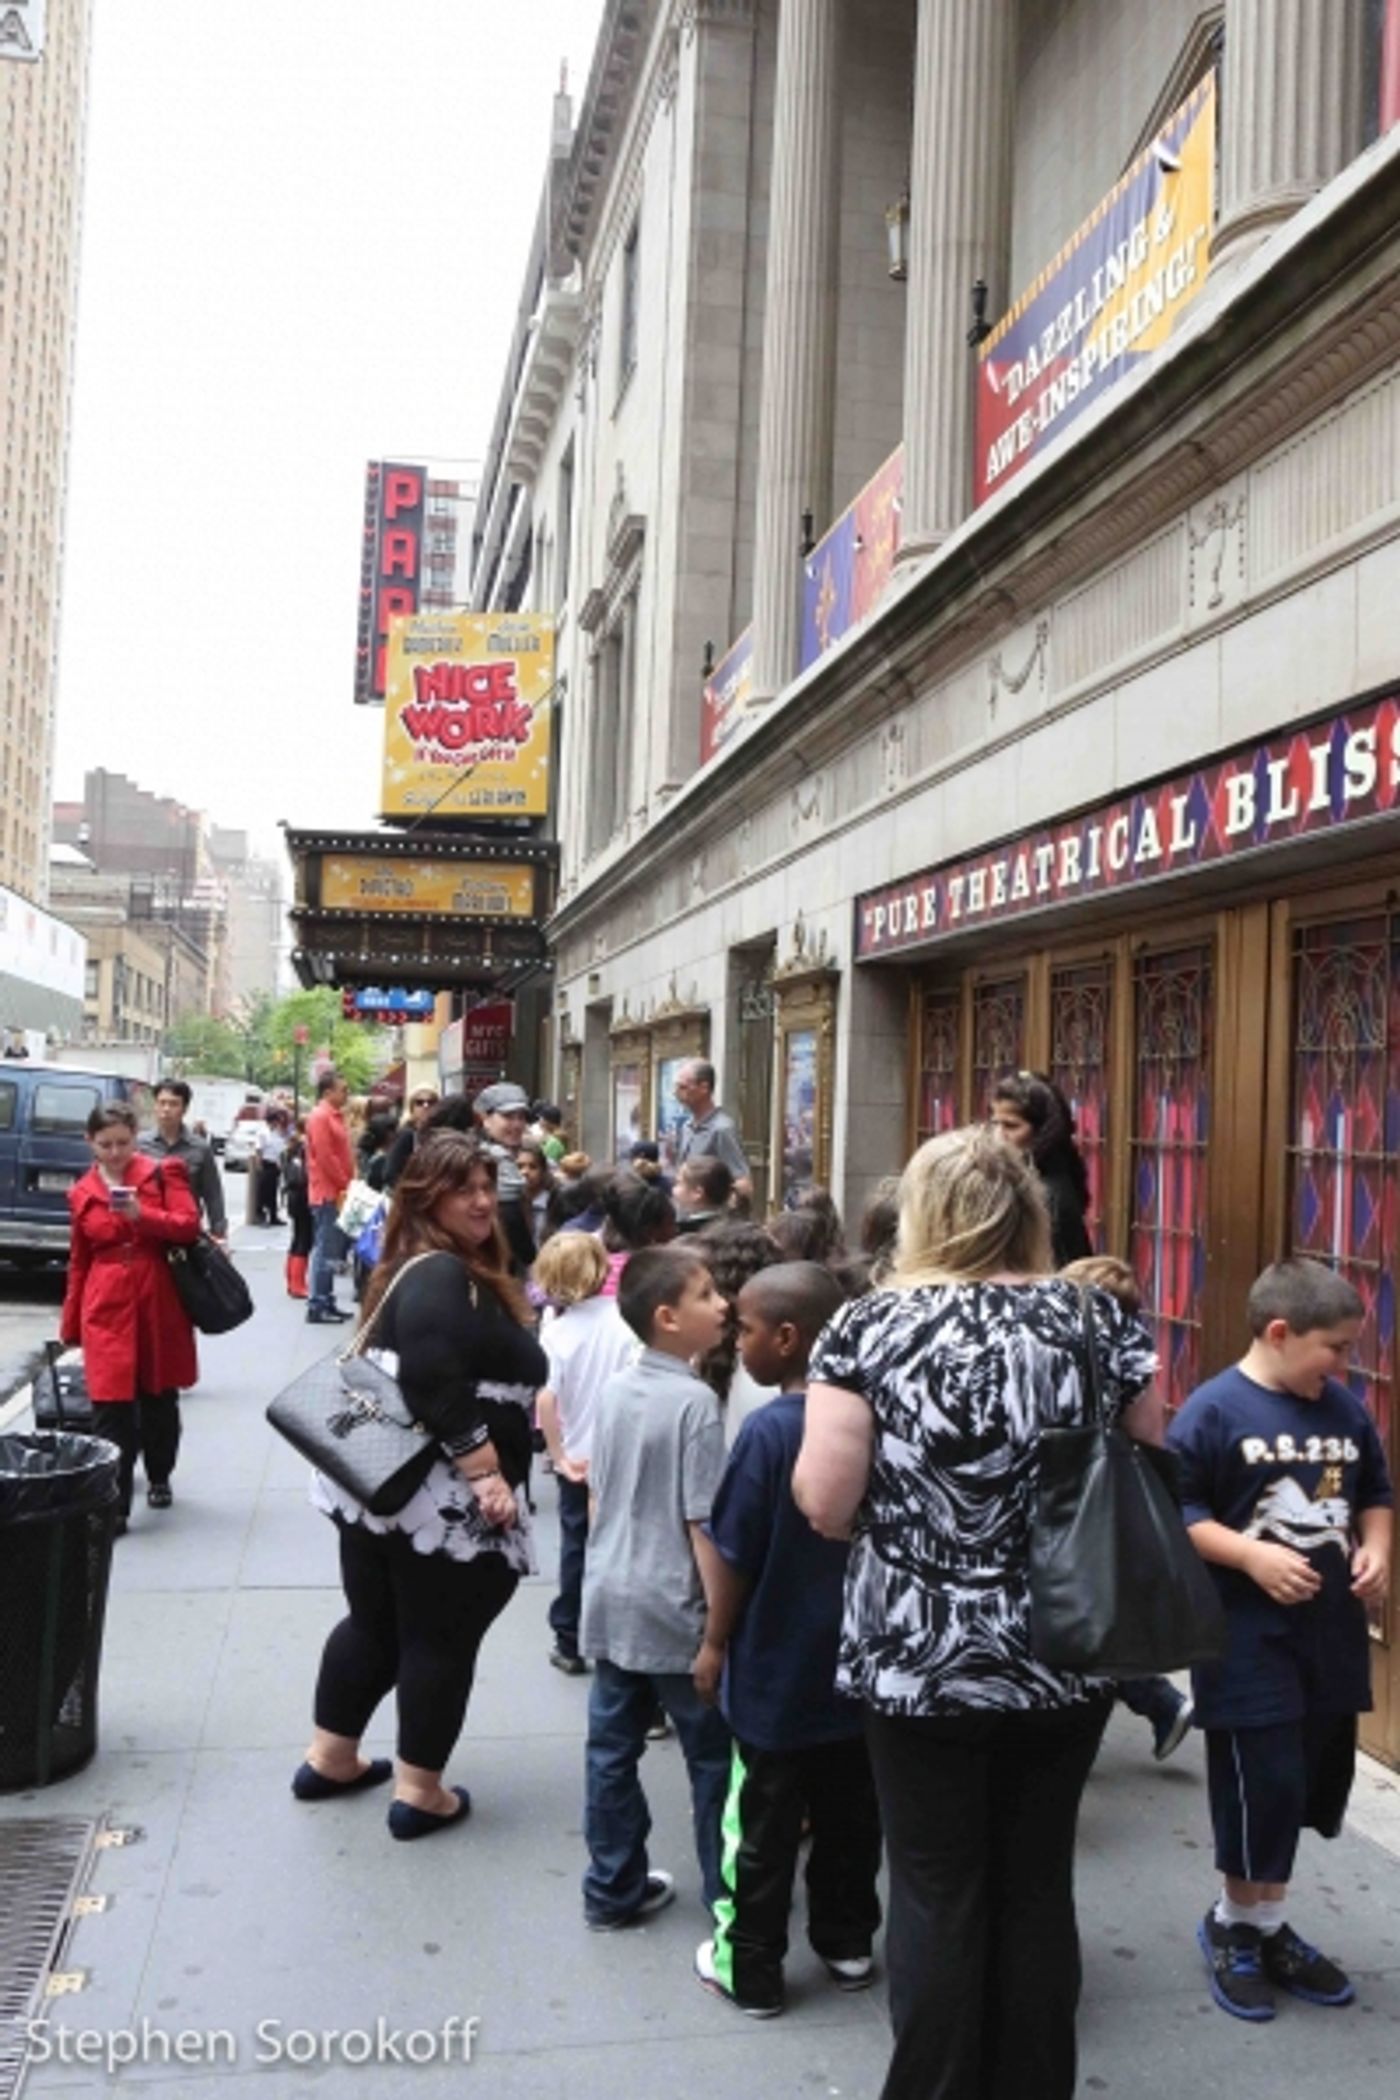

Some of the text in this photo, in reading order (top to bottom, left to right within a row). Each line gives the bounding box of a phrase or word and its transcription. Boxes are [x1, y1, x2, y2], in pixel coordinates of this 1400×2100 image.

[1154, 204, 1175, 247] &
[413, 661, 517, 705] NICE
[401, 702, 534, 750] WORK
[949, 794, 1196, 919] THEATRICAL
